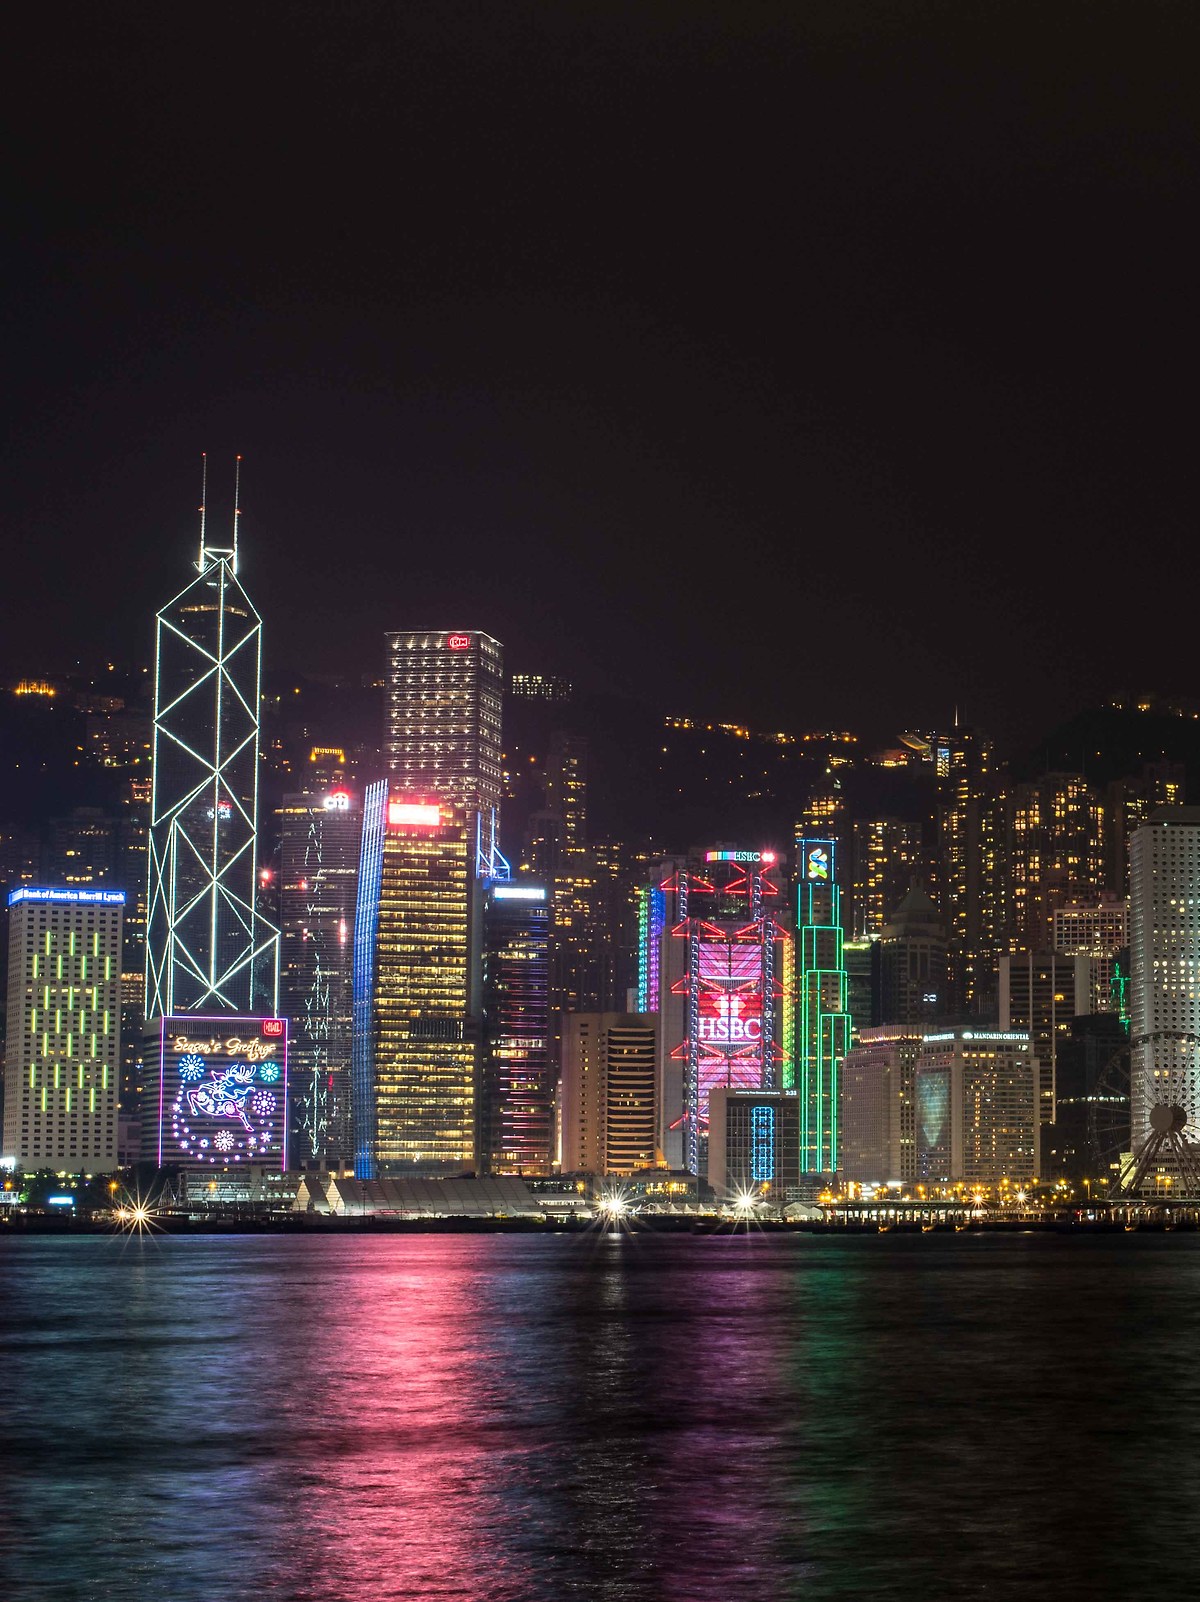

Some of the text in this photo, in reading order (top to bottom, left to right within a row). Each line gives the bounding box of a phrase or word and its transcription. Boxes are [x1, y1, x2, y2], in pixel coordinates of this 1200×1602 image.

[735, 851, 760, 861] HSBC
[23, 889, 42, 898] Bank
[42, 890, 50, 899] of
[49, 890, 78, 900] America
[79, 892, 102, 901] Merrill
[103, 893, 124, 902] Lynch
[698, 1017, 760, 1039] HSBC
[174, 1036, 276, 1061] Season's Greetings
